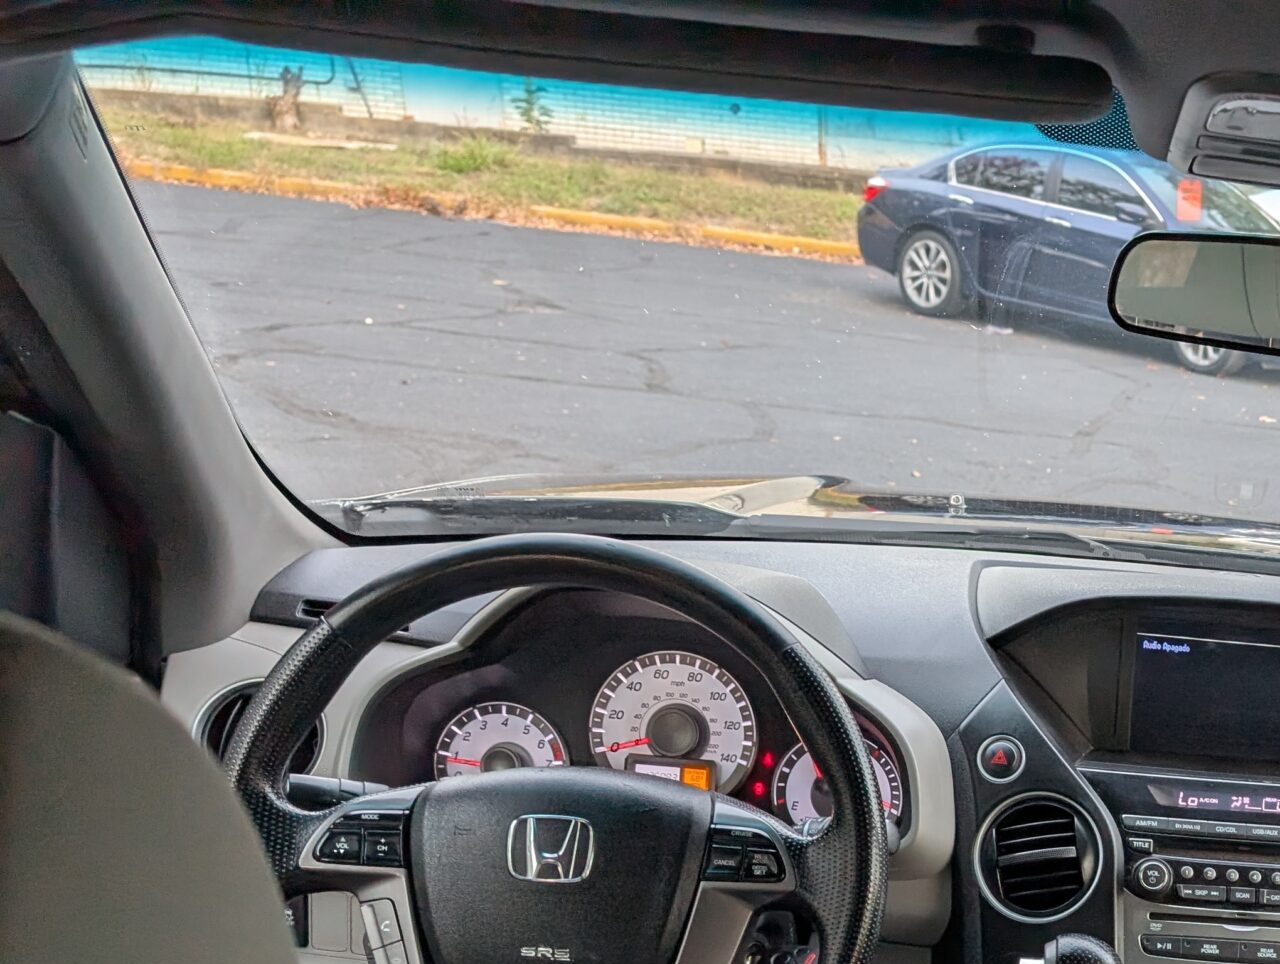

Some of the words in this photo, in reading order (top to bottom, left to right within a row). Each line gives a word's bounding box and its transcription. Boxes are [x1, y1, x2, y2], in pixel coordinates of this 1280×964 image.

[1143, 640, 1161, 650] Audio
[1163, 642, 1190, 653] Apagado
[653, 669, 670, 680] 60
[687, 671, 703, 683] 80
[626, 681, 642, 692] 40
[709, 691, 727, 702] 100
[608, 709, 625, 720] 20
[479, 720, 488, 730] 3
[501, 717, 509, 728] 4
[723, 720, 741, 731] 120
[522, 725, 531, 735] 5
[462, 731, 472, 742] 2
[537, 740, 545, 749] 6
[453, 751, 459, 760] 1
[720, 753, 738, 763] 140
[546, 759, 553, 767] 7
[791, 800, 799, 811] E
[1252, 828, 1279, 836] USB/AUX
[713, 859, 736, 867] CANCEL
[520, 946, 571, 962] SRS
